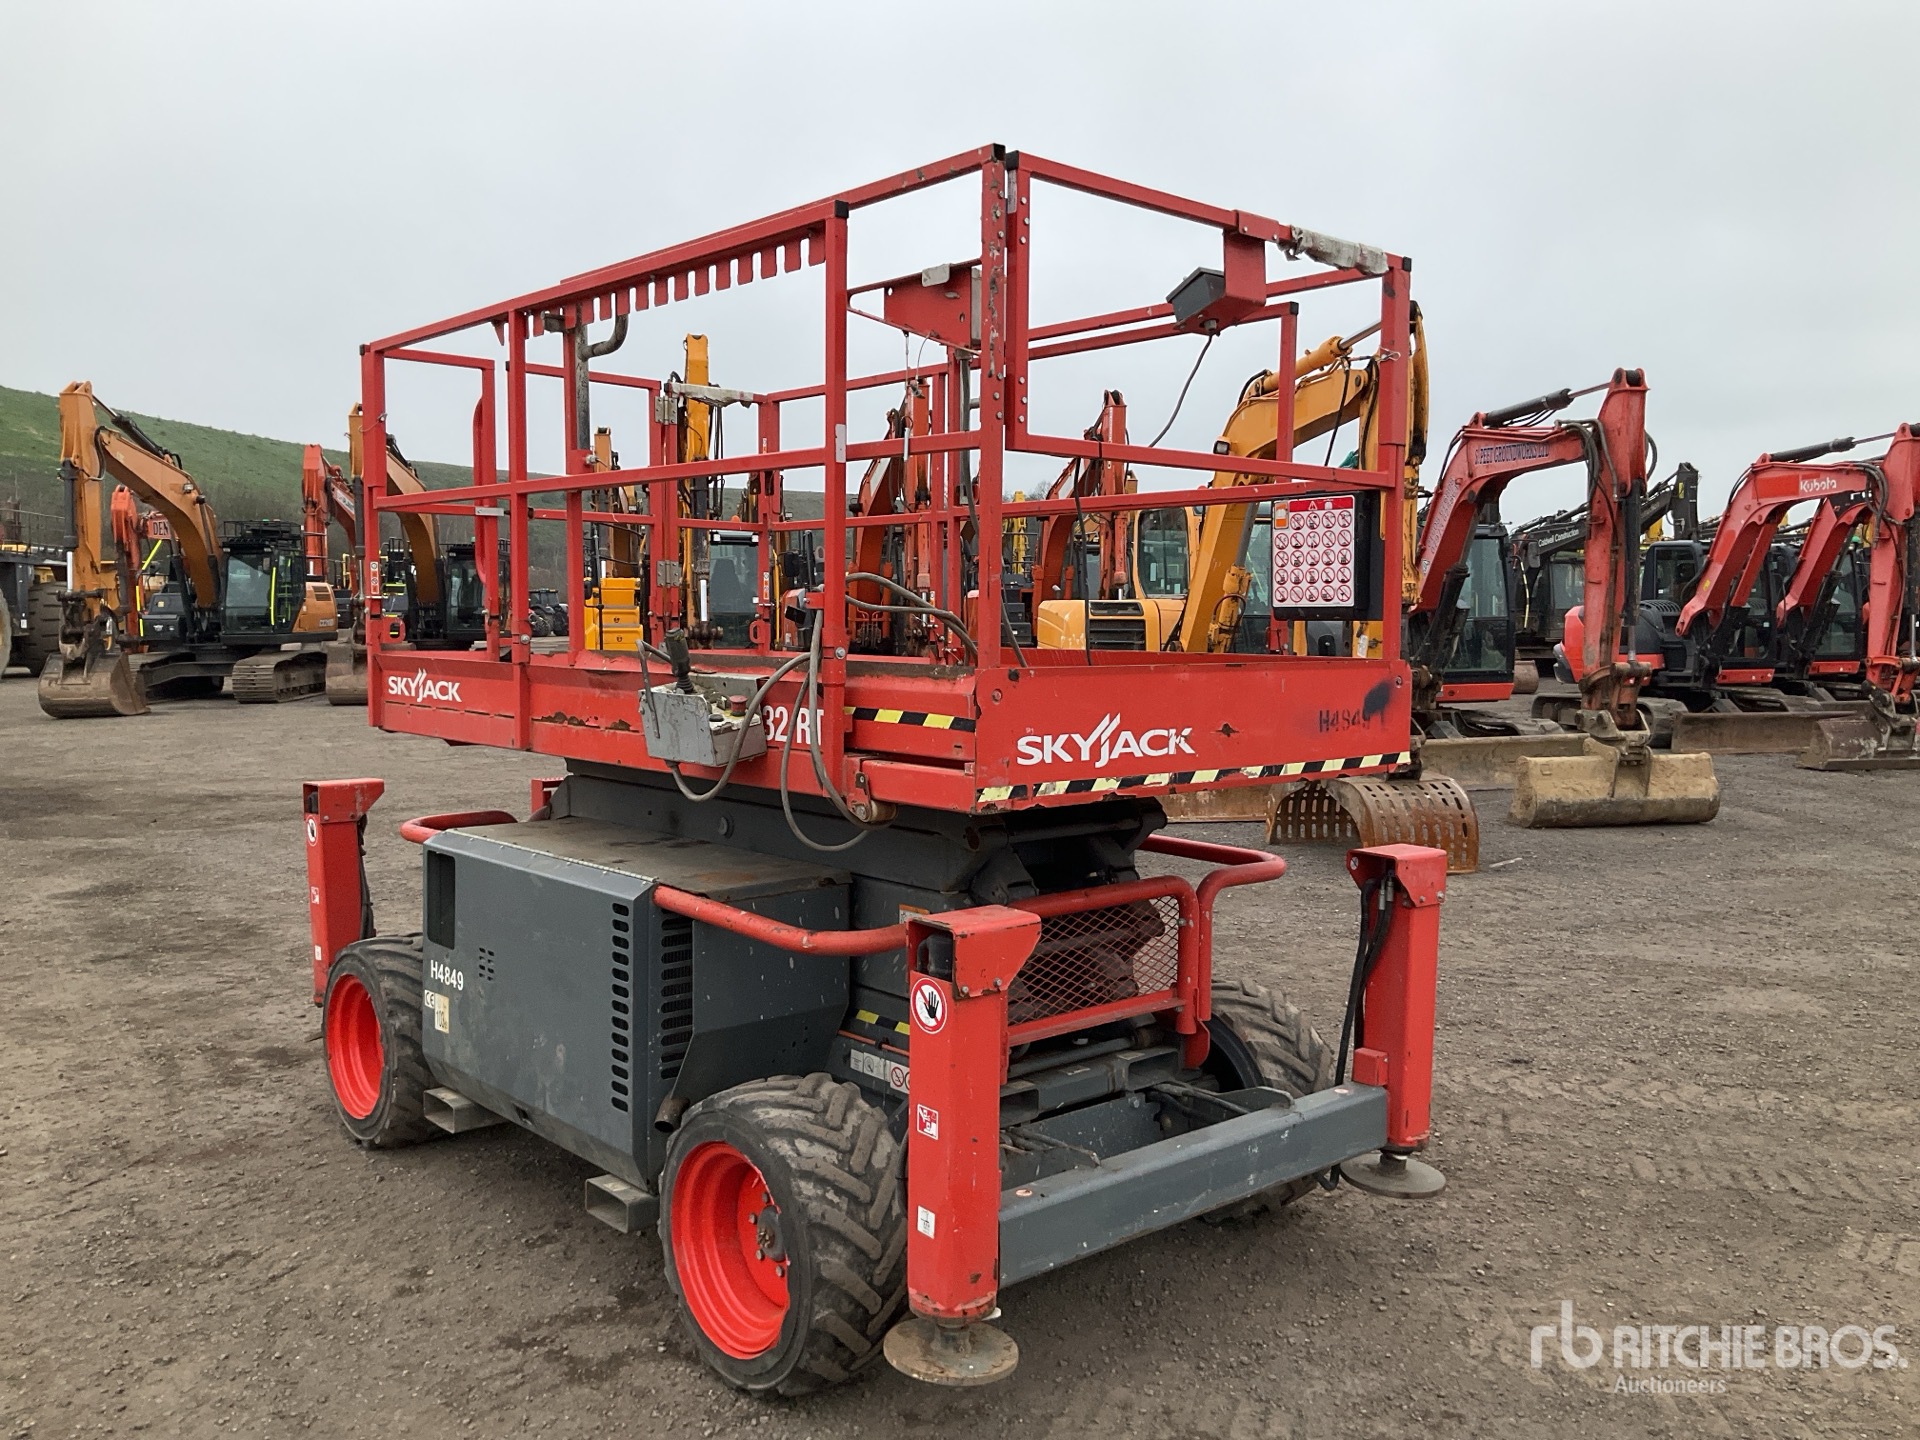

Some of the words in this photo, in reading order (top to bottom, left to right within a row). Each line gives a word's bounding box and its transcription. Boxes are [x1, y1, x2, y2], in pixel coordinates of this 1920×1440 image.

[1801, 477, 1837, 493] Kubota
[388, 668, 462, 702] SKYJACK
[1017, 713, 1195, 768] SKYJACK
[430, 960, 464, 991] H4849
